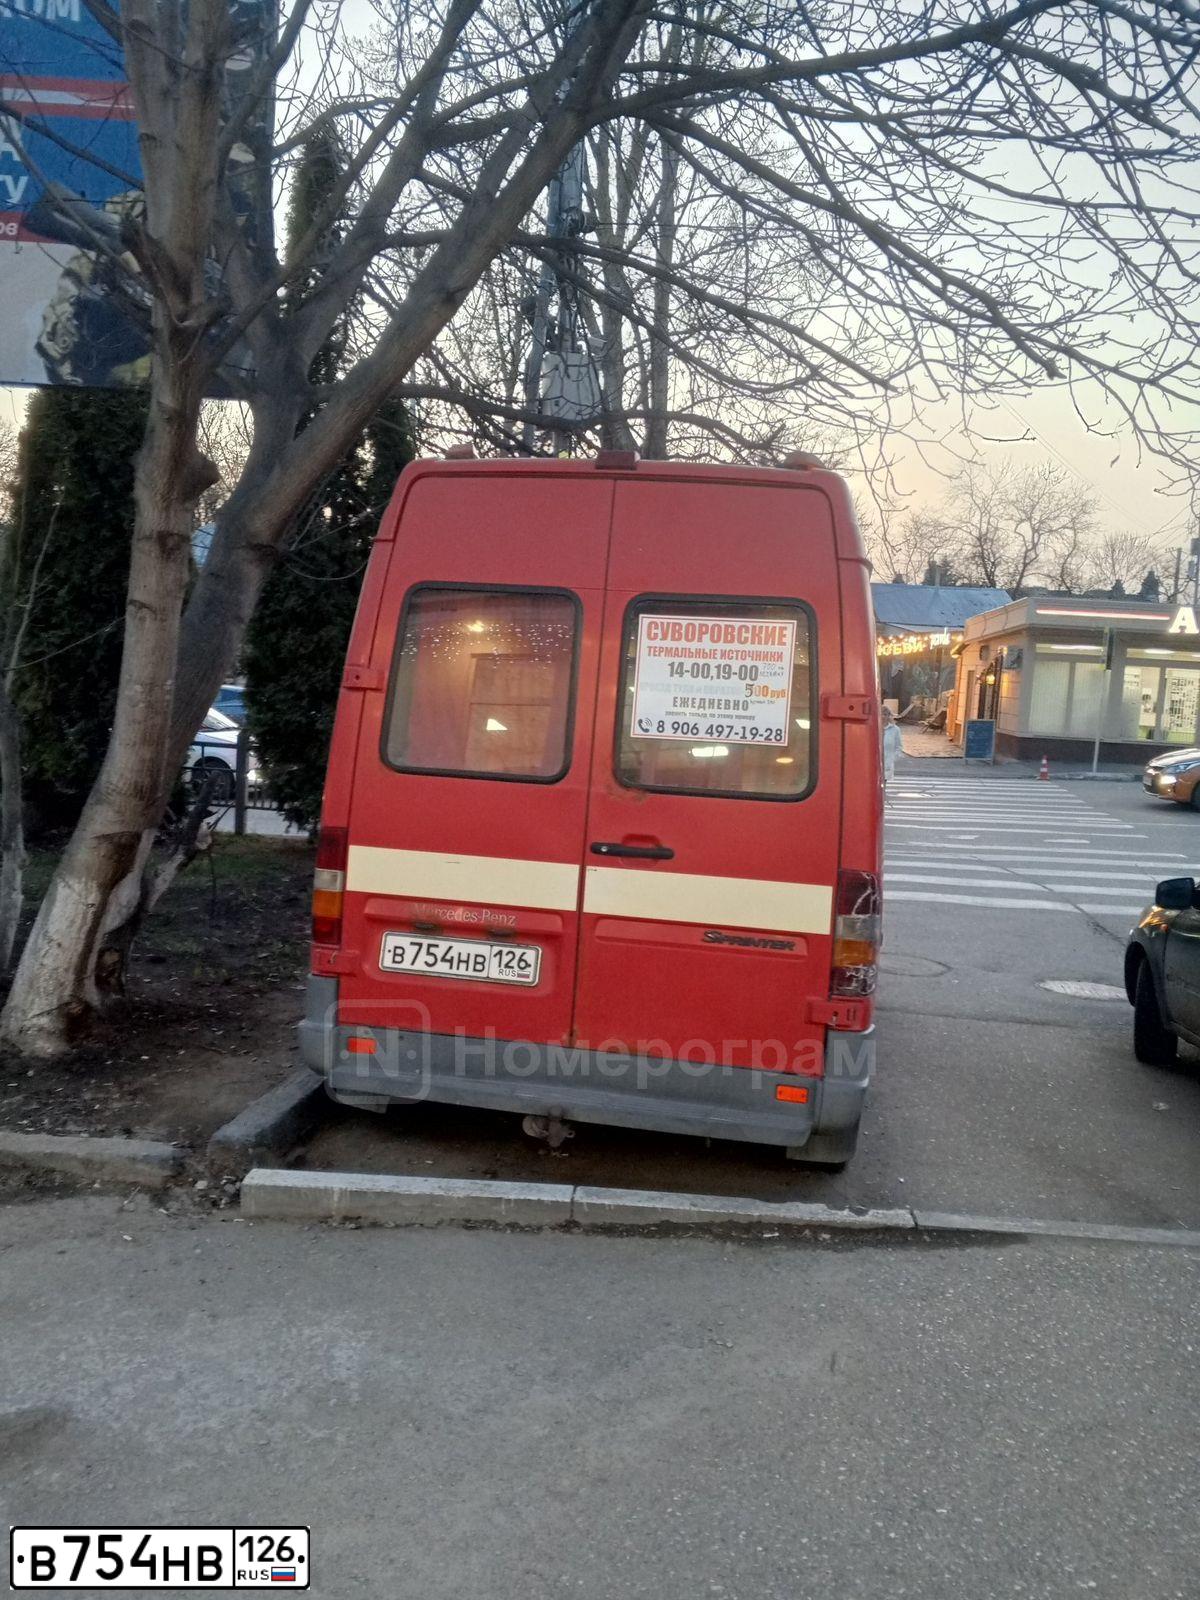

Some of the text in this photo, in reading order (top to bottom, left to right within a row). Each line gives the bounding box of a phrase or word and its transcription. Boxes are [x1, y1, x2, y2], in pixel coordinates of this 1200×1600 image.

[646, 621, 788, 646] СУВОРОВСКИЕ
[647, 646, 784, 662] ТЕРМАЛЬНЫЕ ИСТОЧНИКИ
[668, 661, 759, 682] 14-00,19-00
[744, 683, 769, 698] 500
[672, 696, 750, 712] ЕЖЕДНЕВНО
[656, 720, 783, 741] 8 906 497-19-28
[493, 949, 529, 971] 126
[498, 968, 517, 978] RUS
